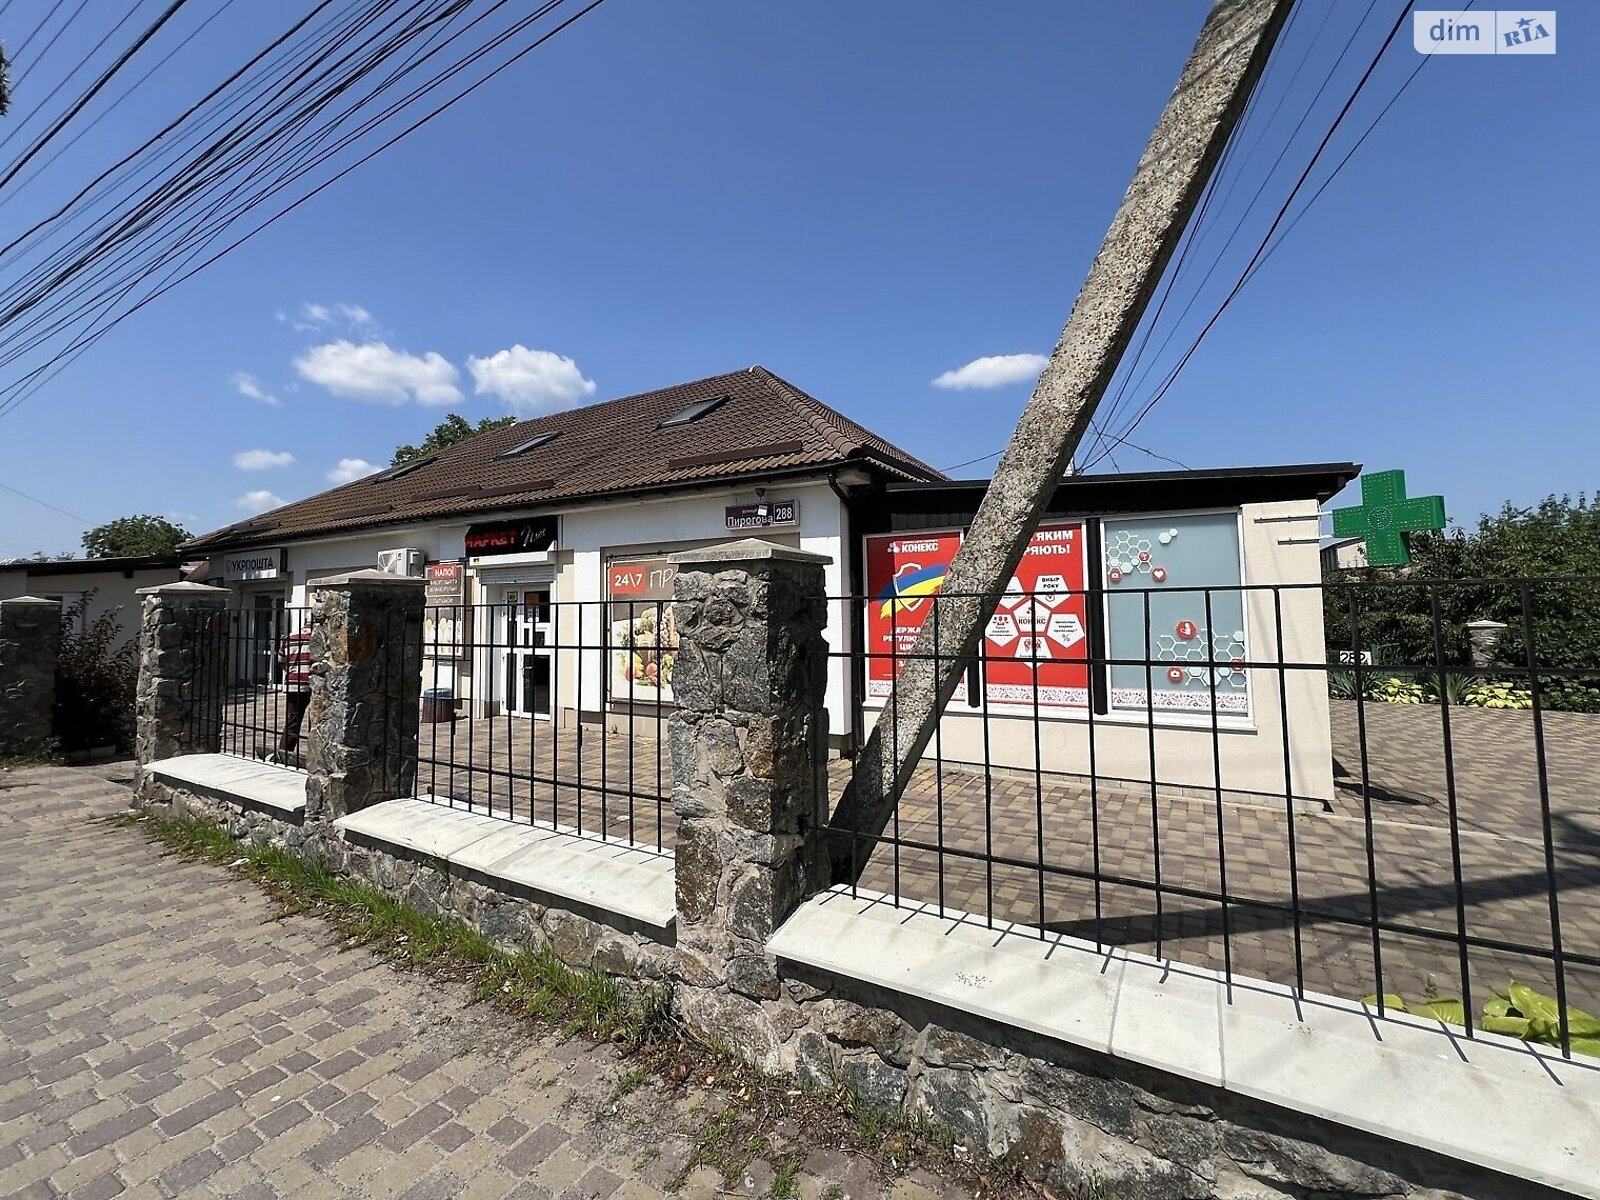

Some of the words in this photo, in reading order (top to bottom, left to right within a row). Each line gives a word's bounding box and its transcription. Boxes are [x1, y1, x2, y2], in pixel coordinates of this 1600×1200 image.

[776, 507, 792, 520] 288
[727, 515, 774, 528] Пирогова
[1036, 530, 1073, 541] ЯКИМ
[901, 543, 938, 553] КОНЕКС
[1023, 543, 1070, 556] РЯЮТЬ!
[232, 558, 274, 571] УКРПОШТА
[649, 568, 674, 589] ПР
